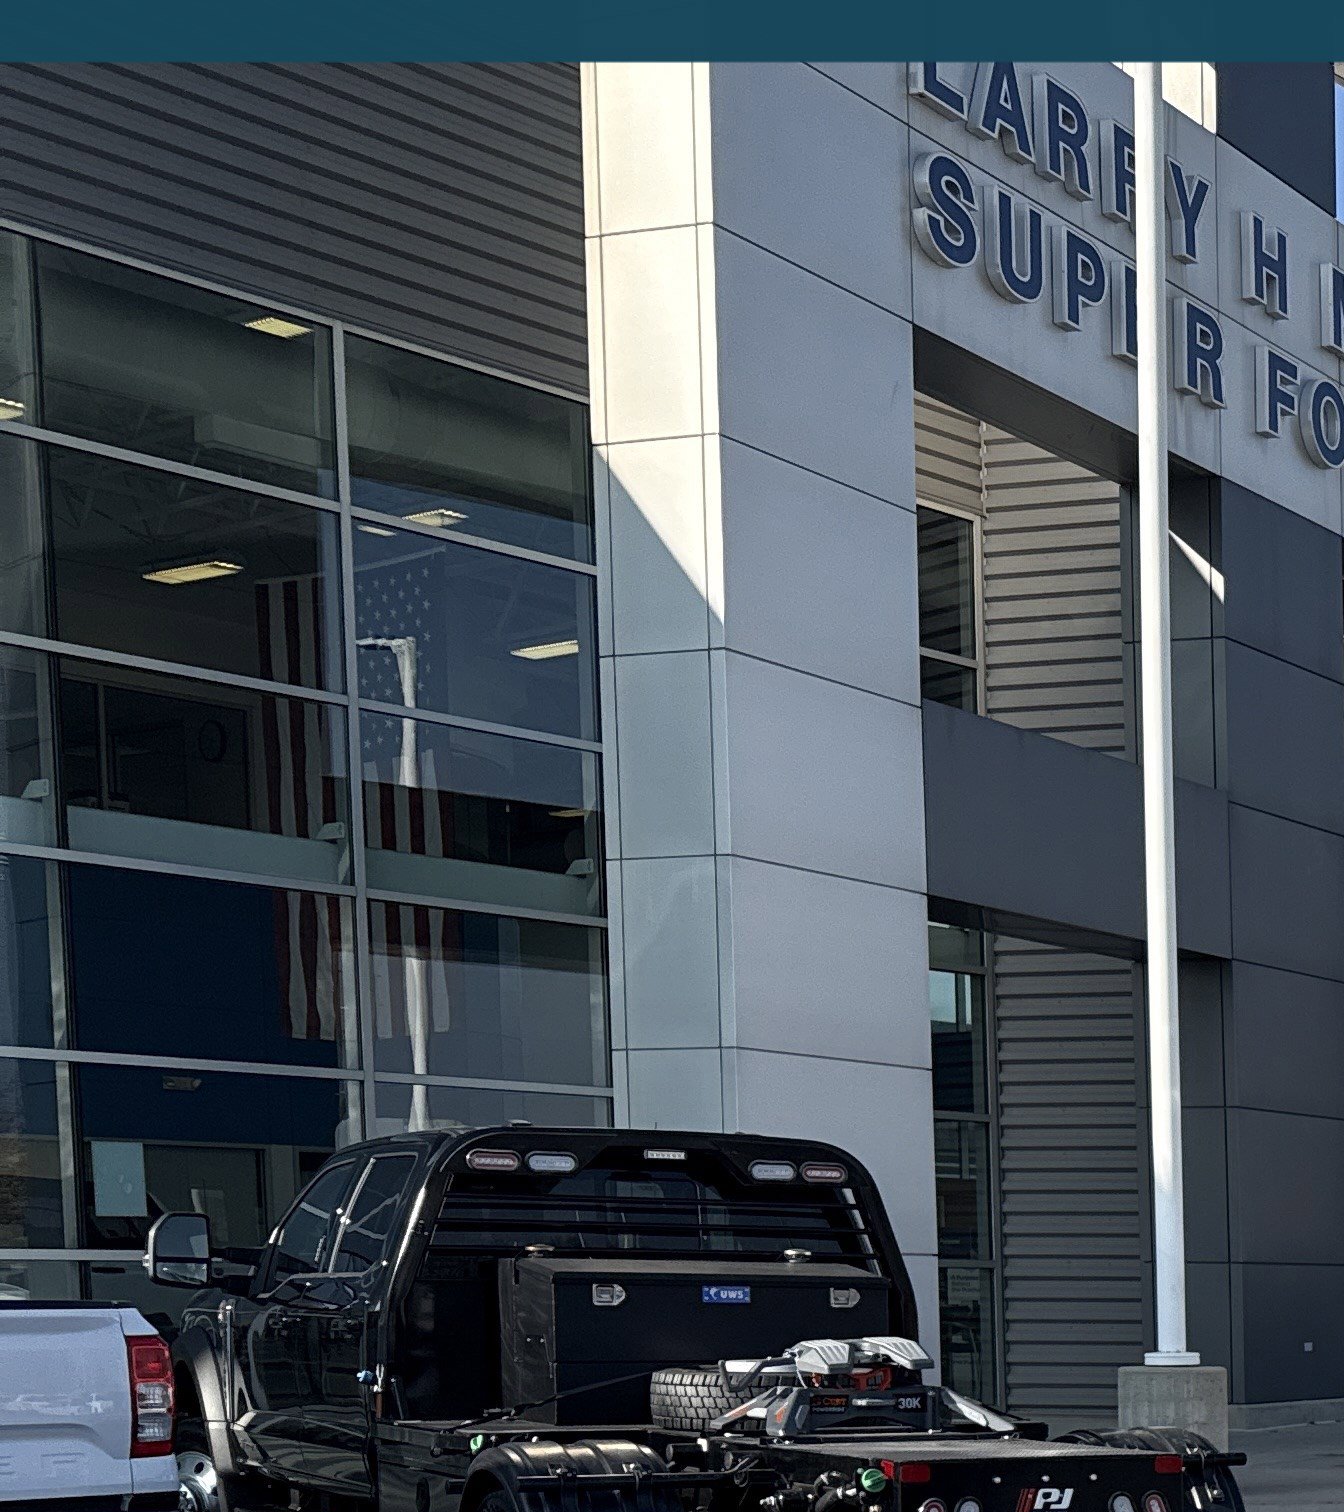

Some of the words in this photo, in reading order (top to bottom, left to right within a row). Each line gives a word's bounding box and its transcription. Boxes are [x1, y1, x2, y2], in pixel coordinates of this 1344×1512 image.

[1241, 210, 1289, 320] H
[720, 1290, 744, 1299] UWS
[898, 1396, 922, 1410] 30K
[1033, 1487, 1075, 1510] PJ
